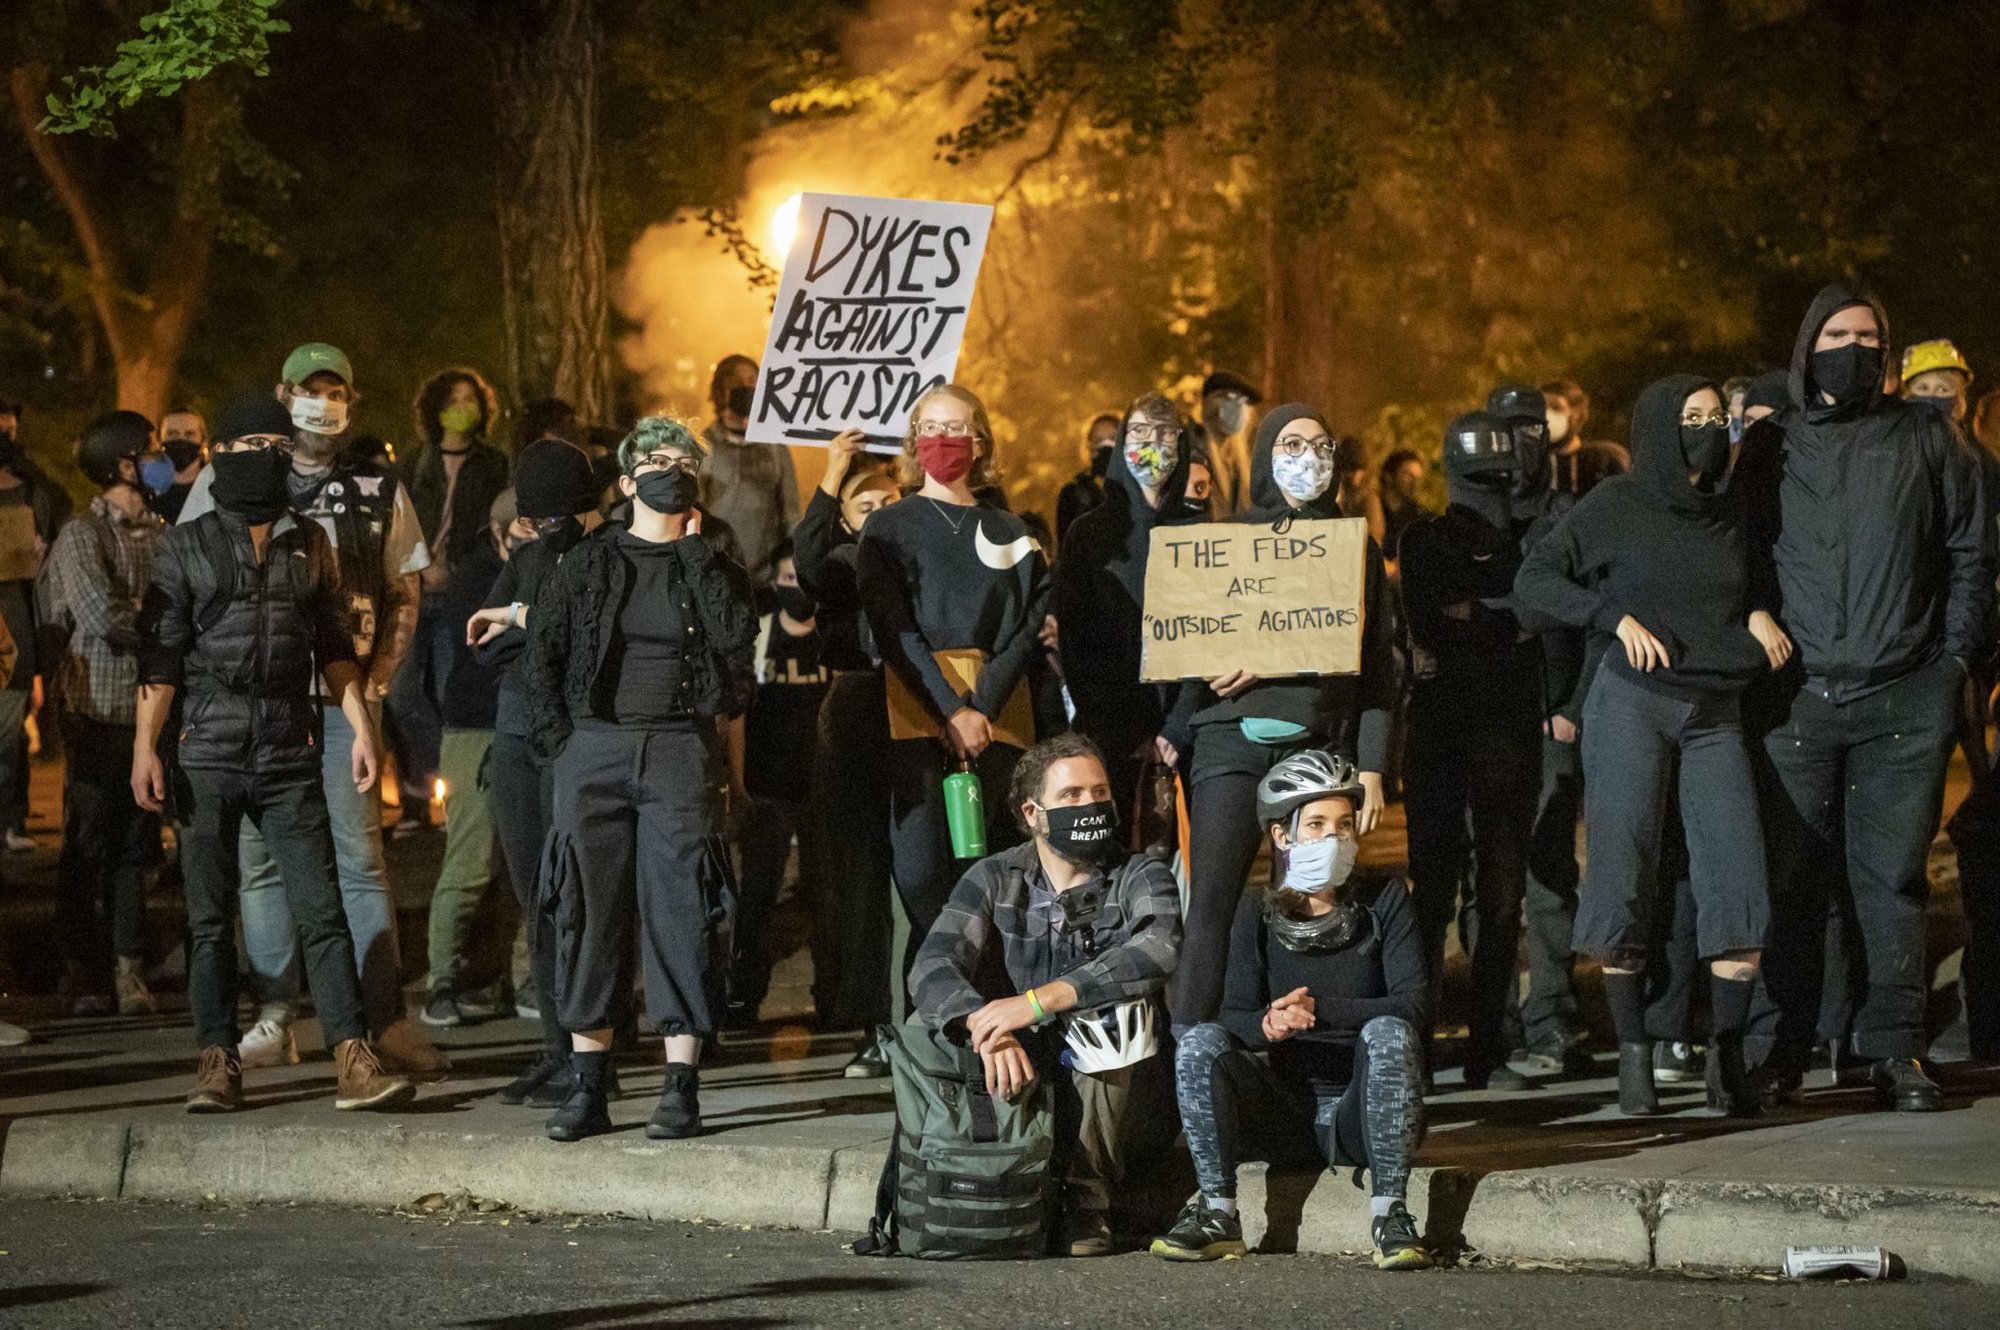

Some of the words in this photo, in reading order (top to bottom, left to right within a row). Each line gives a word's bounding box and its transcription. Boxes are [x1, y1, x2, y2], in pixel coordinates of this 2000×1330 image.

[805, 206, 971, 298] DYKES
[774, 288, 966, 360] AGAINST
[757, 364, 947, 424] RACISM
[1165, 538, 1232, 568] THE
[1253, 534, 1327, 563] FEDS
[1226, 576, 1276, 598] ARE
[1258, 606, 1359, 632] AGITATORS
[1073, 818, 1079, 828] I
